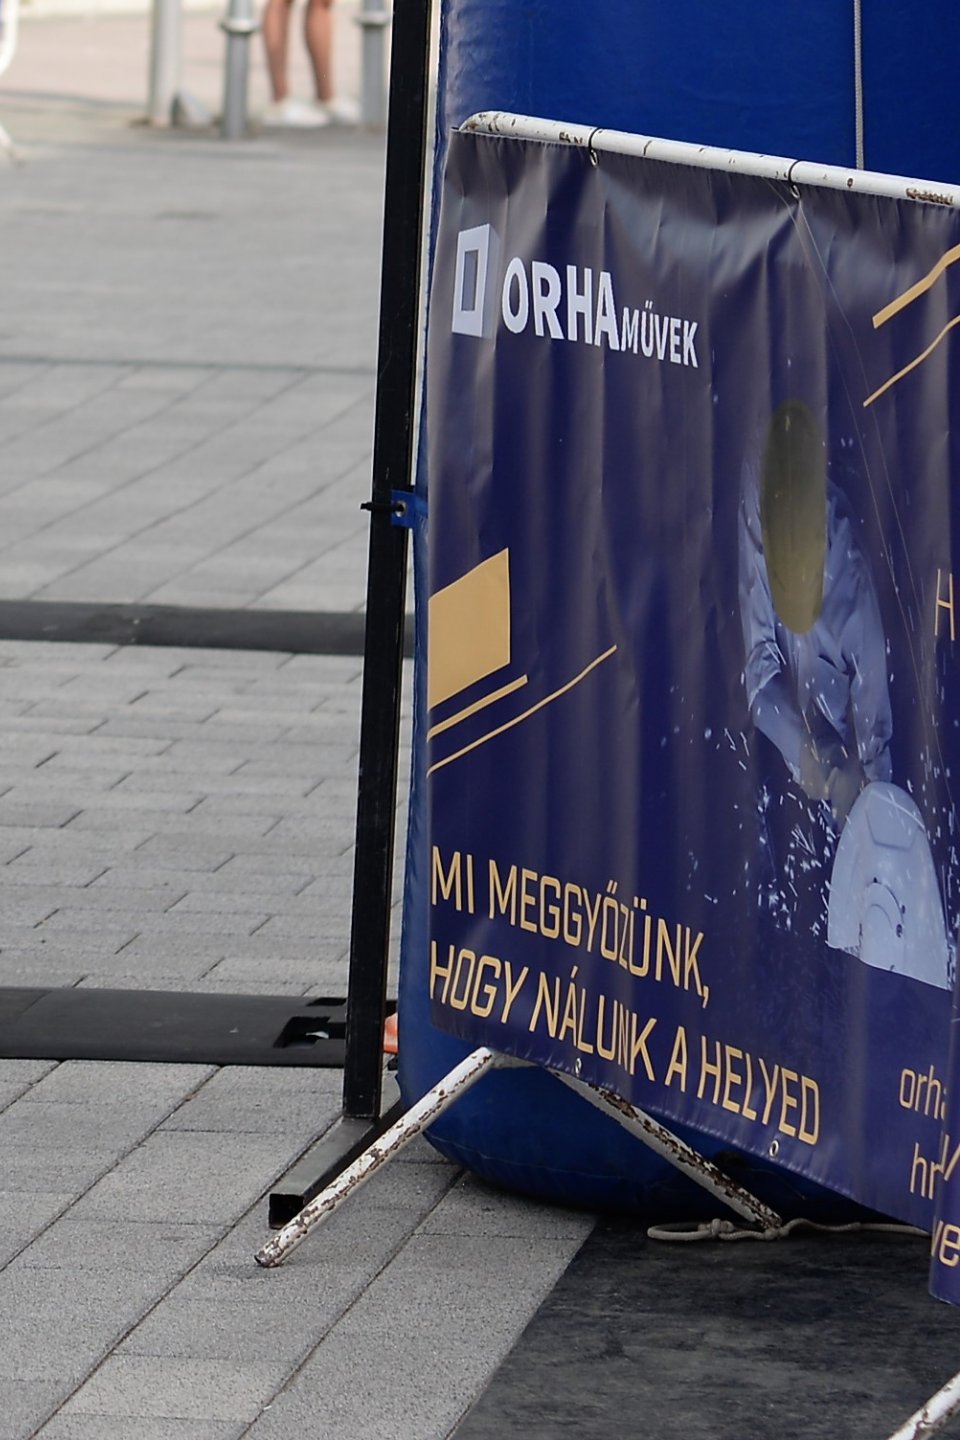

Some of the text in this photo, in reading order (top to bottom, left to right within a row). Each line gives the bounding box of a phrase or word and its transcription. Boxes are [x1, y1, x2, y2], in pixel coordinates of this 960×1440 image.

[501, 256, 699, 369] ORHAMŰVEK
[431, 846, 710, 1008] MI MEGGYŐZÜNK,
[429, 940, 820, 1145] HOGY NÁLUNK A HELYED
